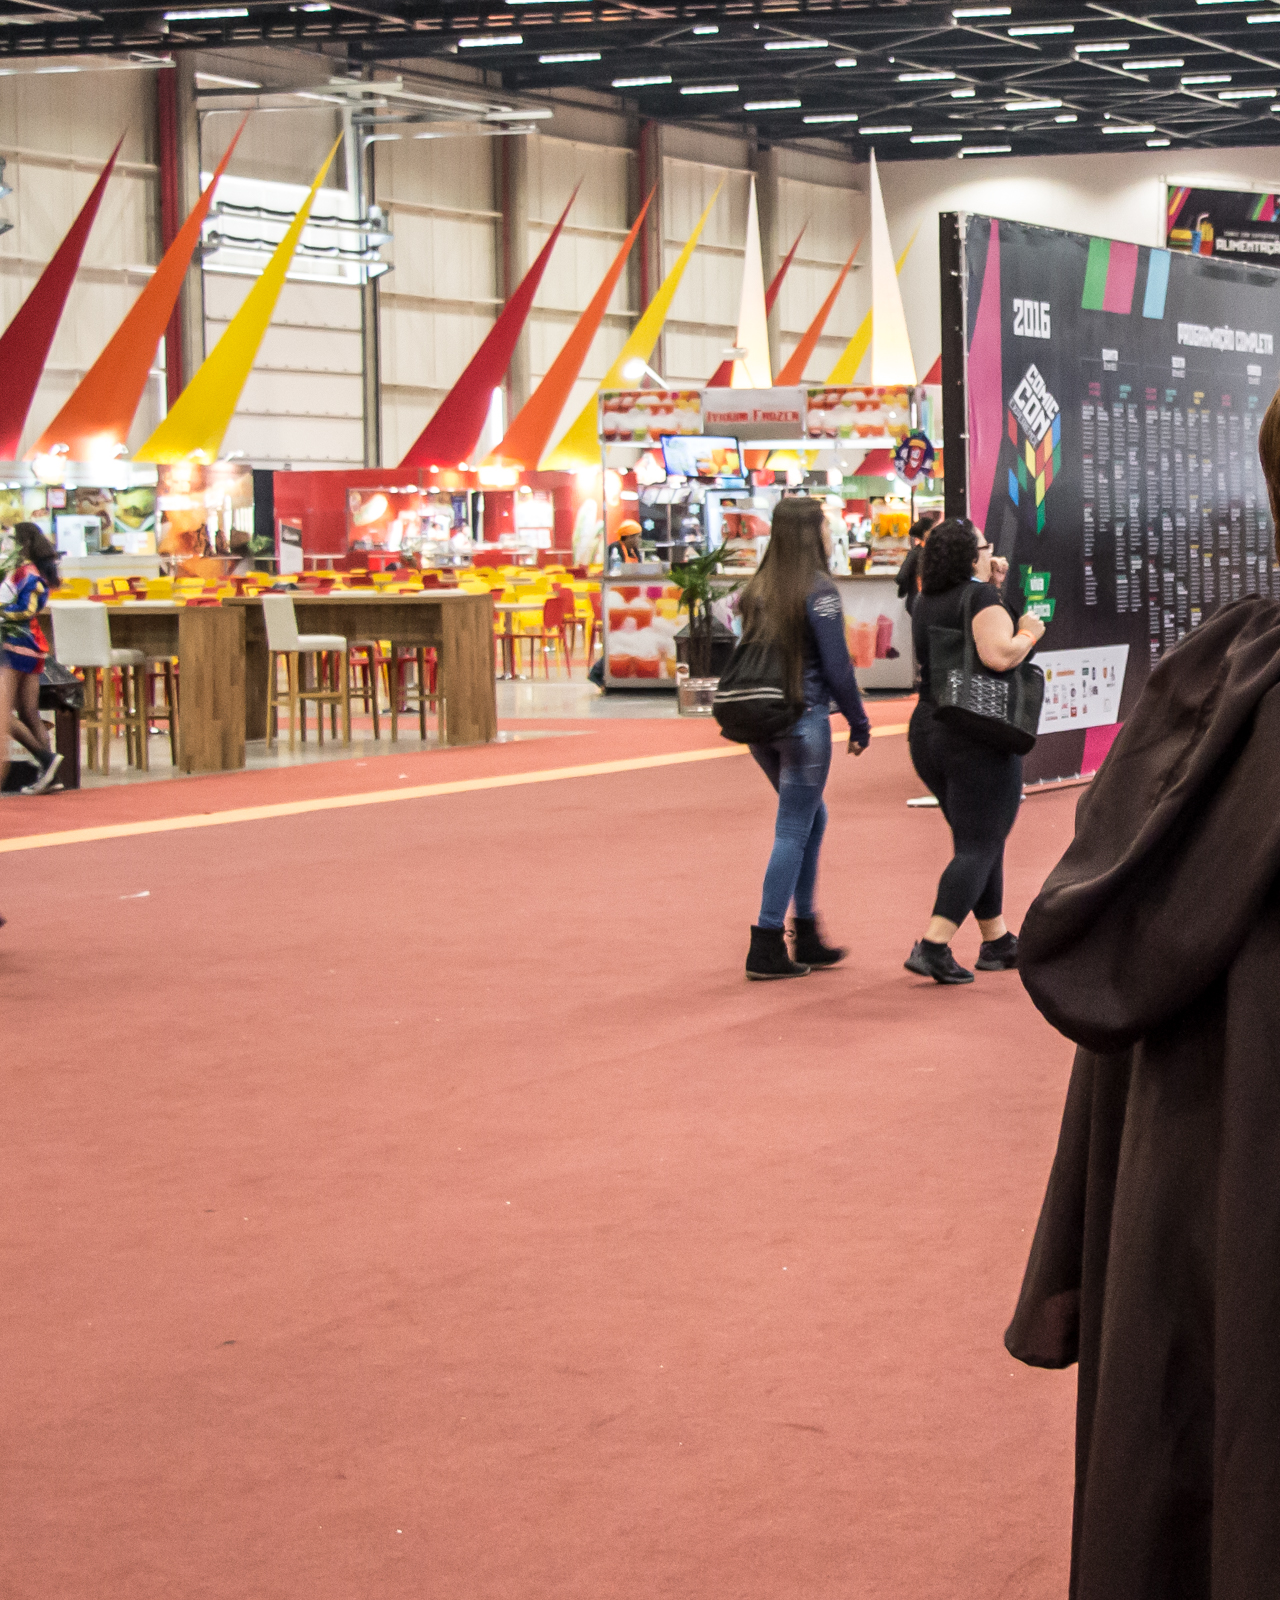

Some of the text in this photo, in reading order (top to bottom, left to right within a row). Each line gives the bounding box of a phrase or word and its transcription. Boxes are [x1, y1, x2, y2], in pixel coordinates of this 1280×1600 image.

[1013, 298, 1051, 340] 2016
[1013, 378, 1051, 441] CON
[1026, 363, 1060, 420] COMIC
